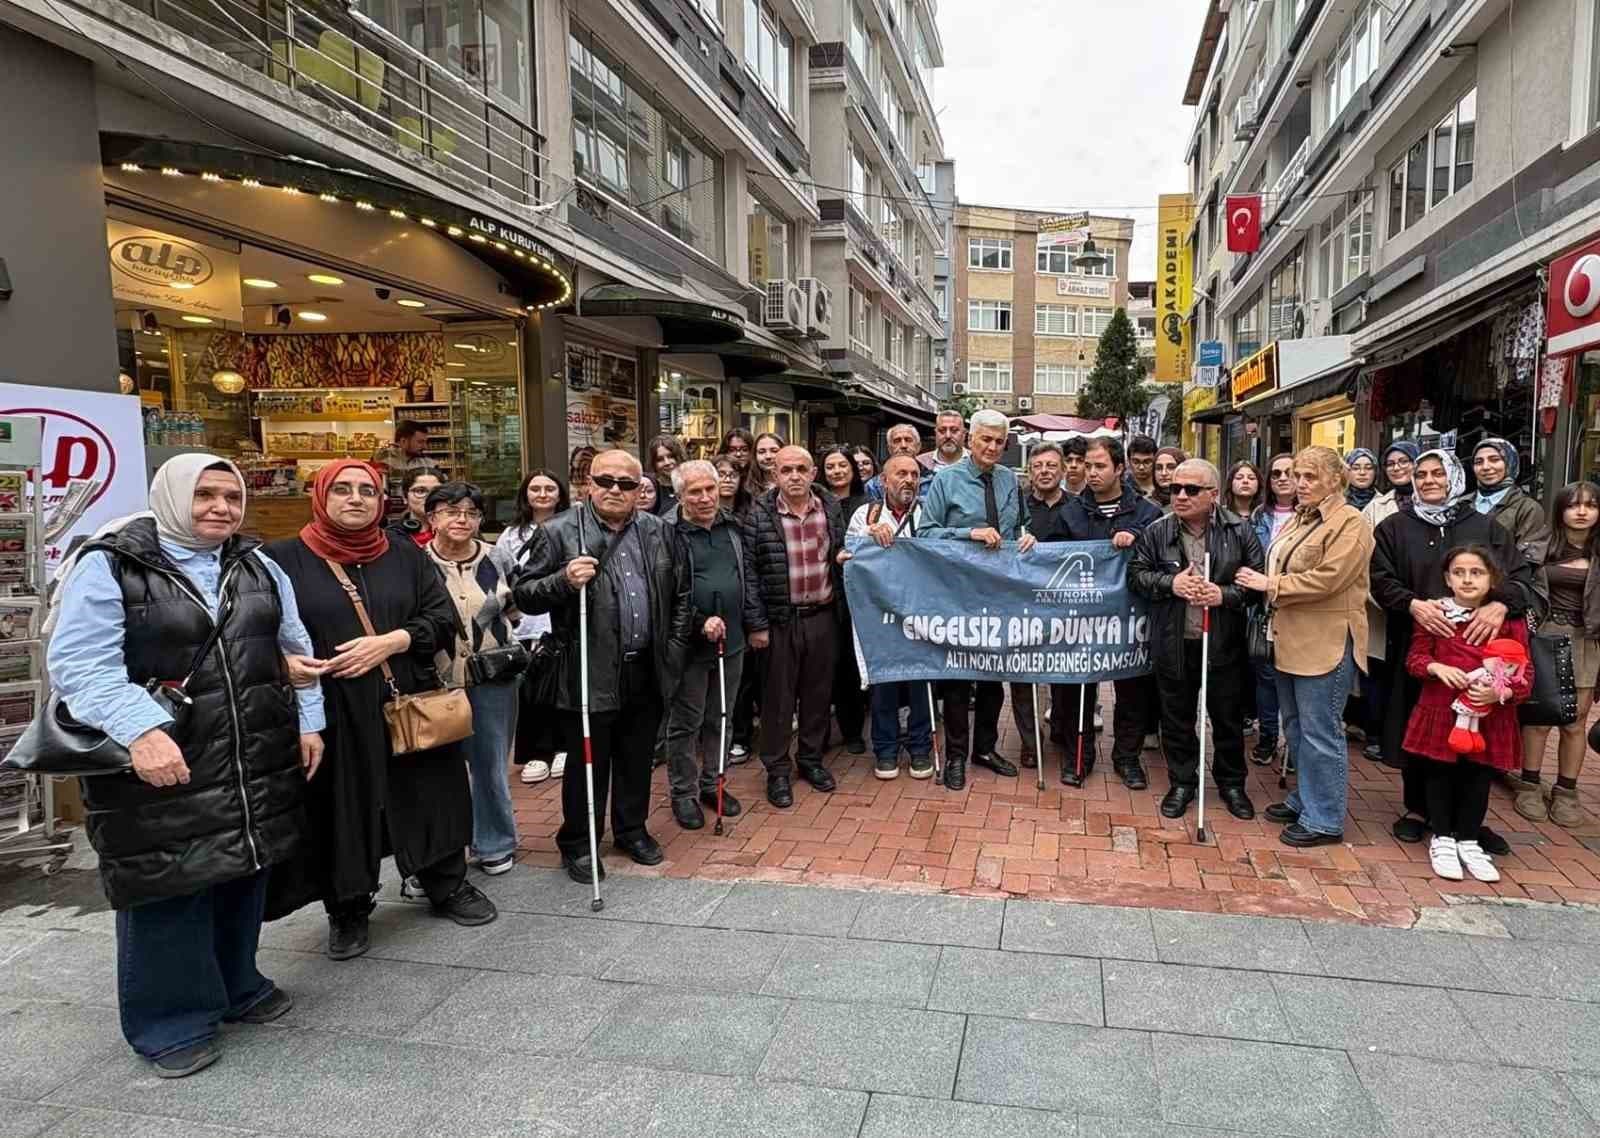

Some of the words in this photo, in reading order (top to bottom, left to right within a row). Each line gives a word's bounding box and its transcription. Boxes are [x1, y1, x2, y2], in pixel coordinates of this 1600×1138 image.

[469, 216, 496, 234] ALP
[121, 242, 201, 276] alp
[1165, 228, 1178, 311] AKADEMİ
[902, 607, 1002, 648] ENGELSİZ
[1007, 607, 1044, 647] BİR
[1049, 608, 1122, 645] DÜNYA
[945, 649, 967, 669] ALTI
[969, 653, 1004, 673] NOKTA
[1006, 648, 1044, 673] KÖRLER
[1046, 646, 1091, 673] DERNEĞİ
[1093, 647, 1149, 672] SAMSUN
